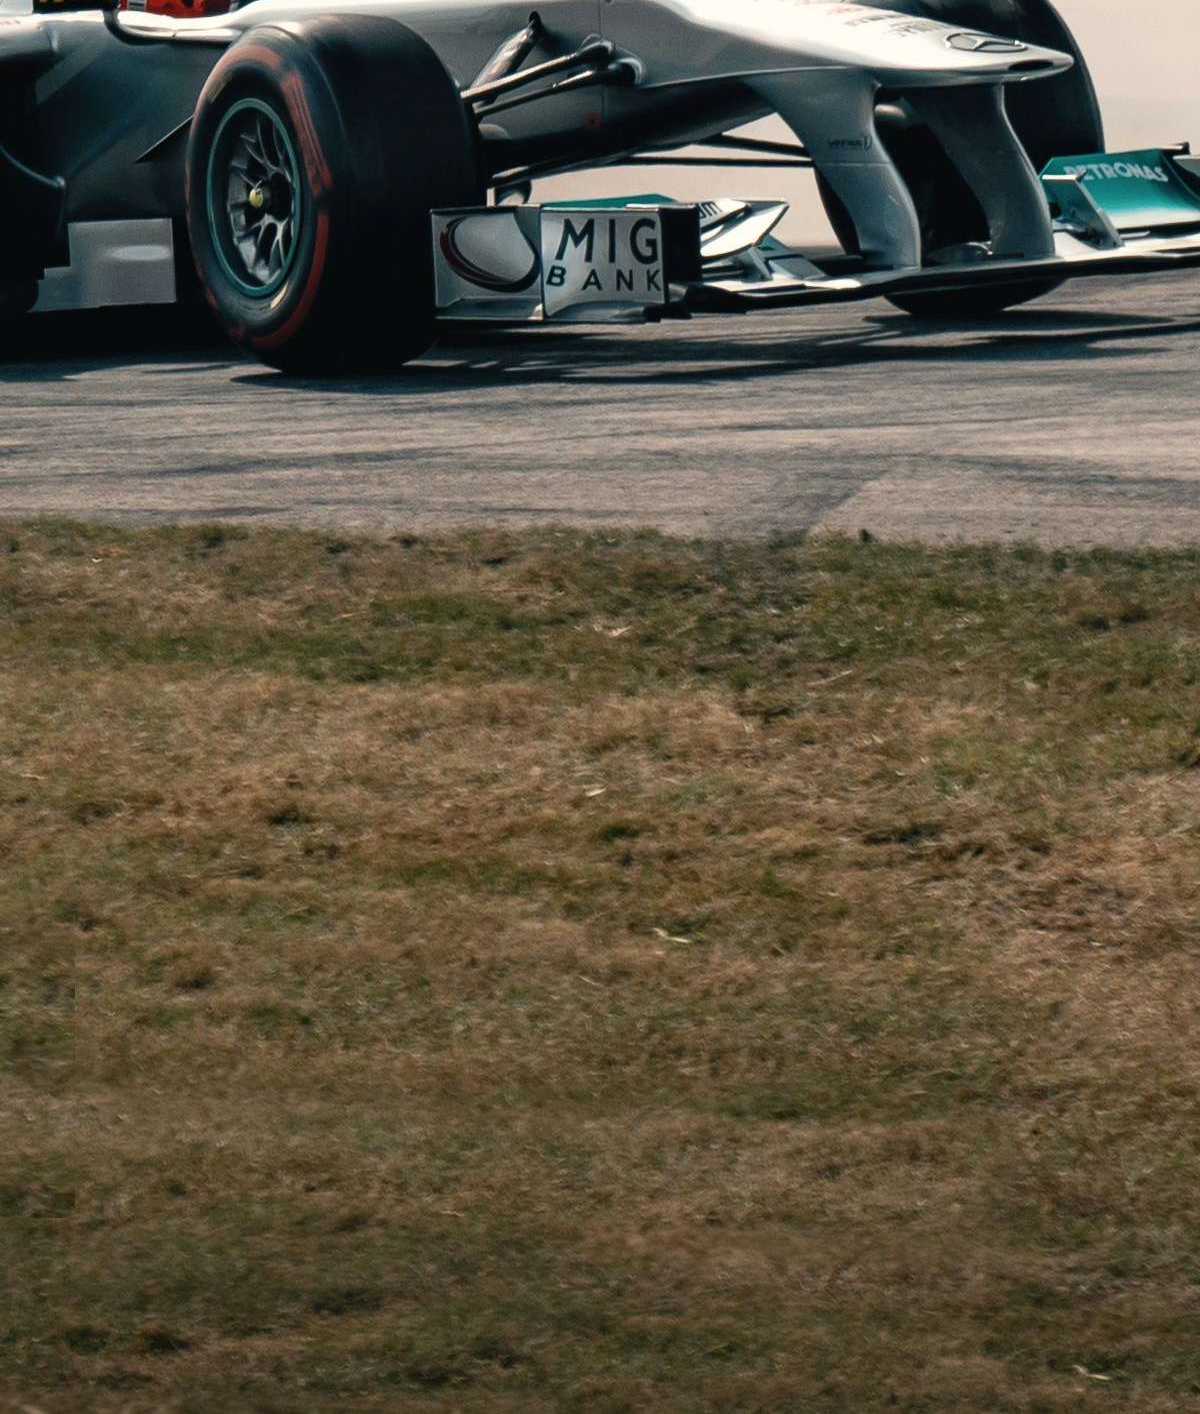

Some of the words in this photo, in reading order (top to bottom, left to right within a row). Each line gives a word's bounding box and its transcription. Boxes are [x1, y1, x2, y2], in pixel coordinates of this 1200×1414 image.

[1063, 162, 1168, 182] PETRONAS
[554, 217, 659, 264] MIG
[546, 266, 662, 291] BANK
